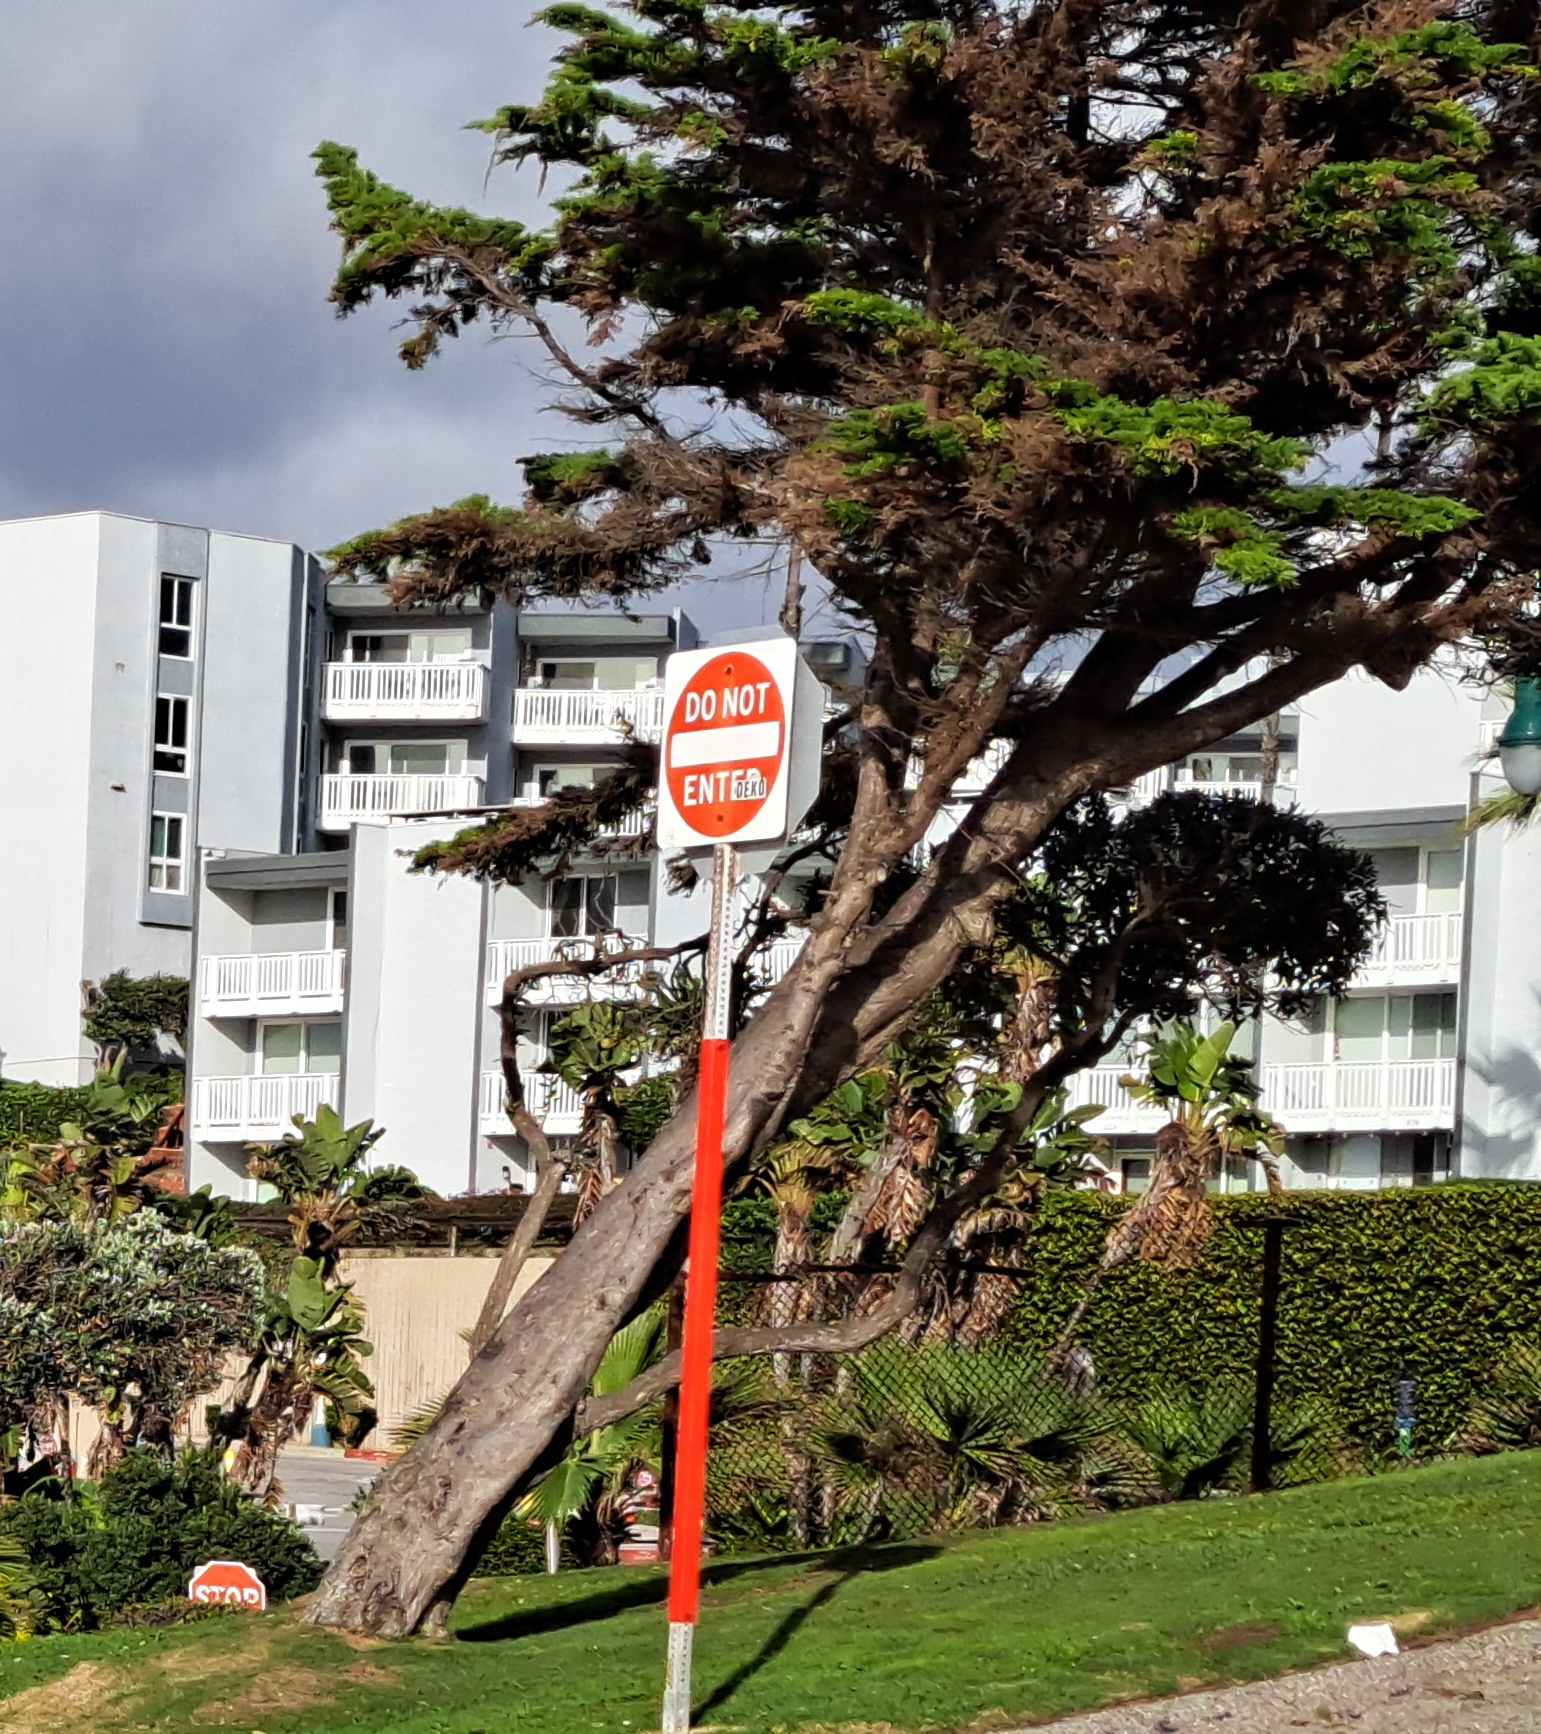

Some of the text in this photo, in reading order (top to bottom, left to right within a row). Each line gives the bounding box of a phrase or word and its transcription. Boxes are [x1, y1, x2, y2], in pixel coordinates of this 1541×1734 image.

[684, 682, 772, 722] DO NOT
[196, 1584, 259, 1605] STOP
